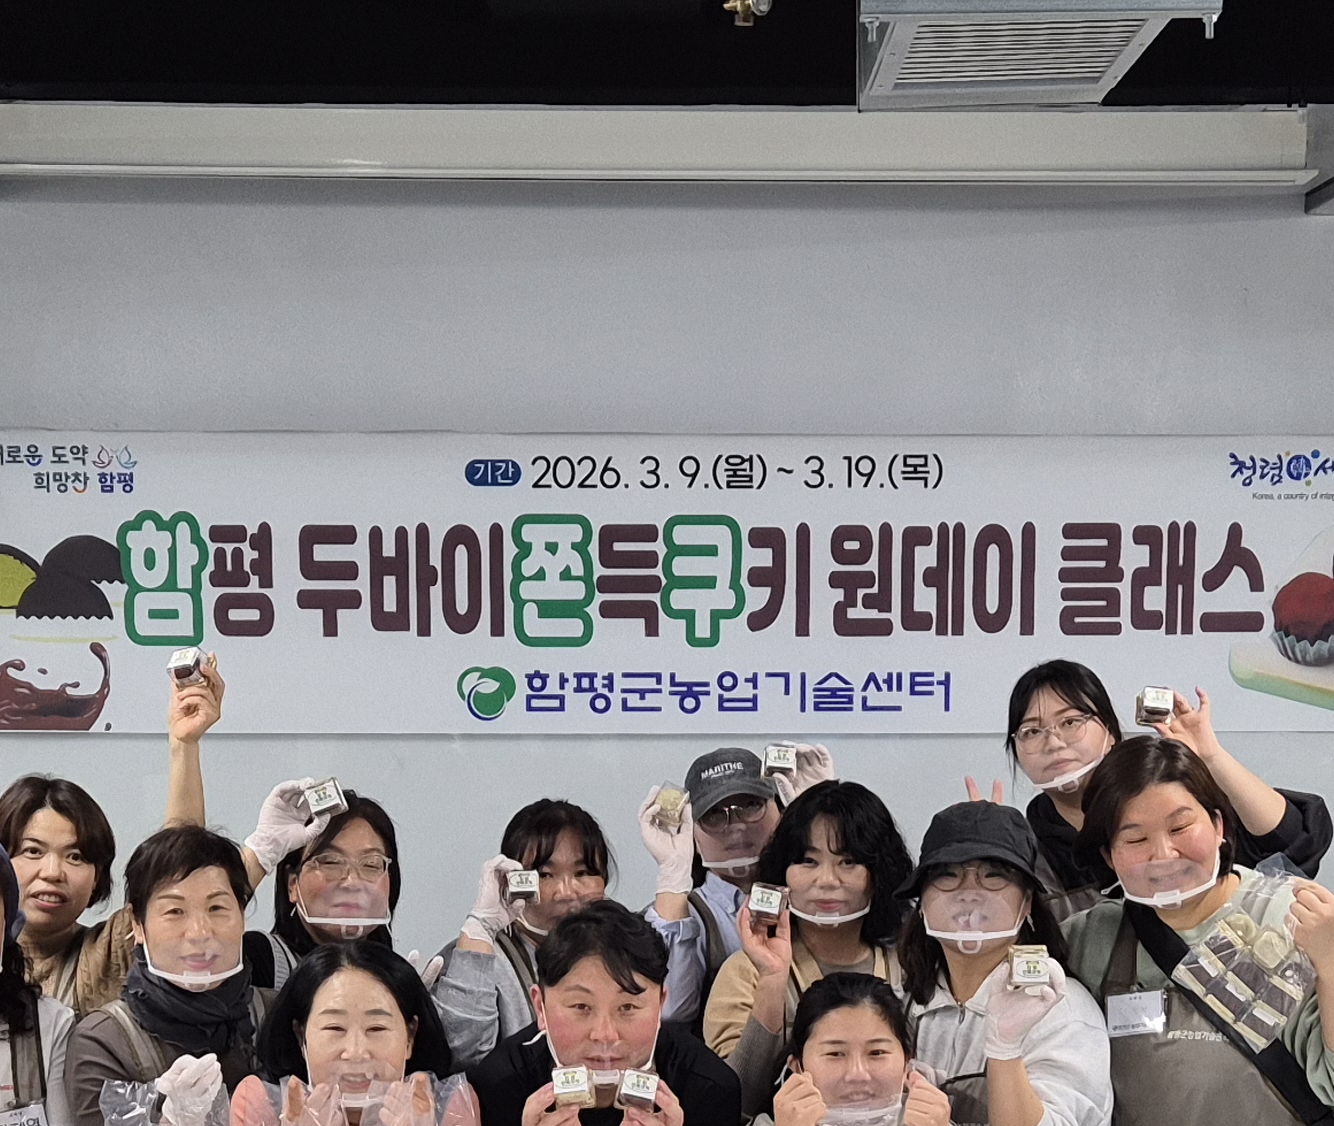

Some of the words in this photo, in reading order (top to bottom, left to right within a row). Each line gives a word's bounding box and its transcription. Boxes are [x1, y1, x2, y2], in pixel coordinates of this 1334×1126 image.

[49, 443, 90, 466] 도약
[33, 471, 90, 494] 희망찬
[97, 471, 135, 494] 함평
[471, 460, 516, 484] 기간
[530, 454, 630, 490] 2026.
[639, 454, 670, 490] 3.
[679, 452, 768, 491] 9.(월)
[116, 509, 276, 648] 함평
[297, 512, 811, 648] 두바이쫀득쿠키
[829, 520, 1037, 637] 원데이
[1058, 519, 1266, 636] 클래스
[524, 668, 952, 715] 함평군농업기술센터
